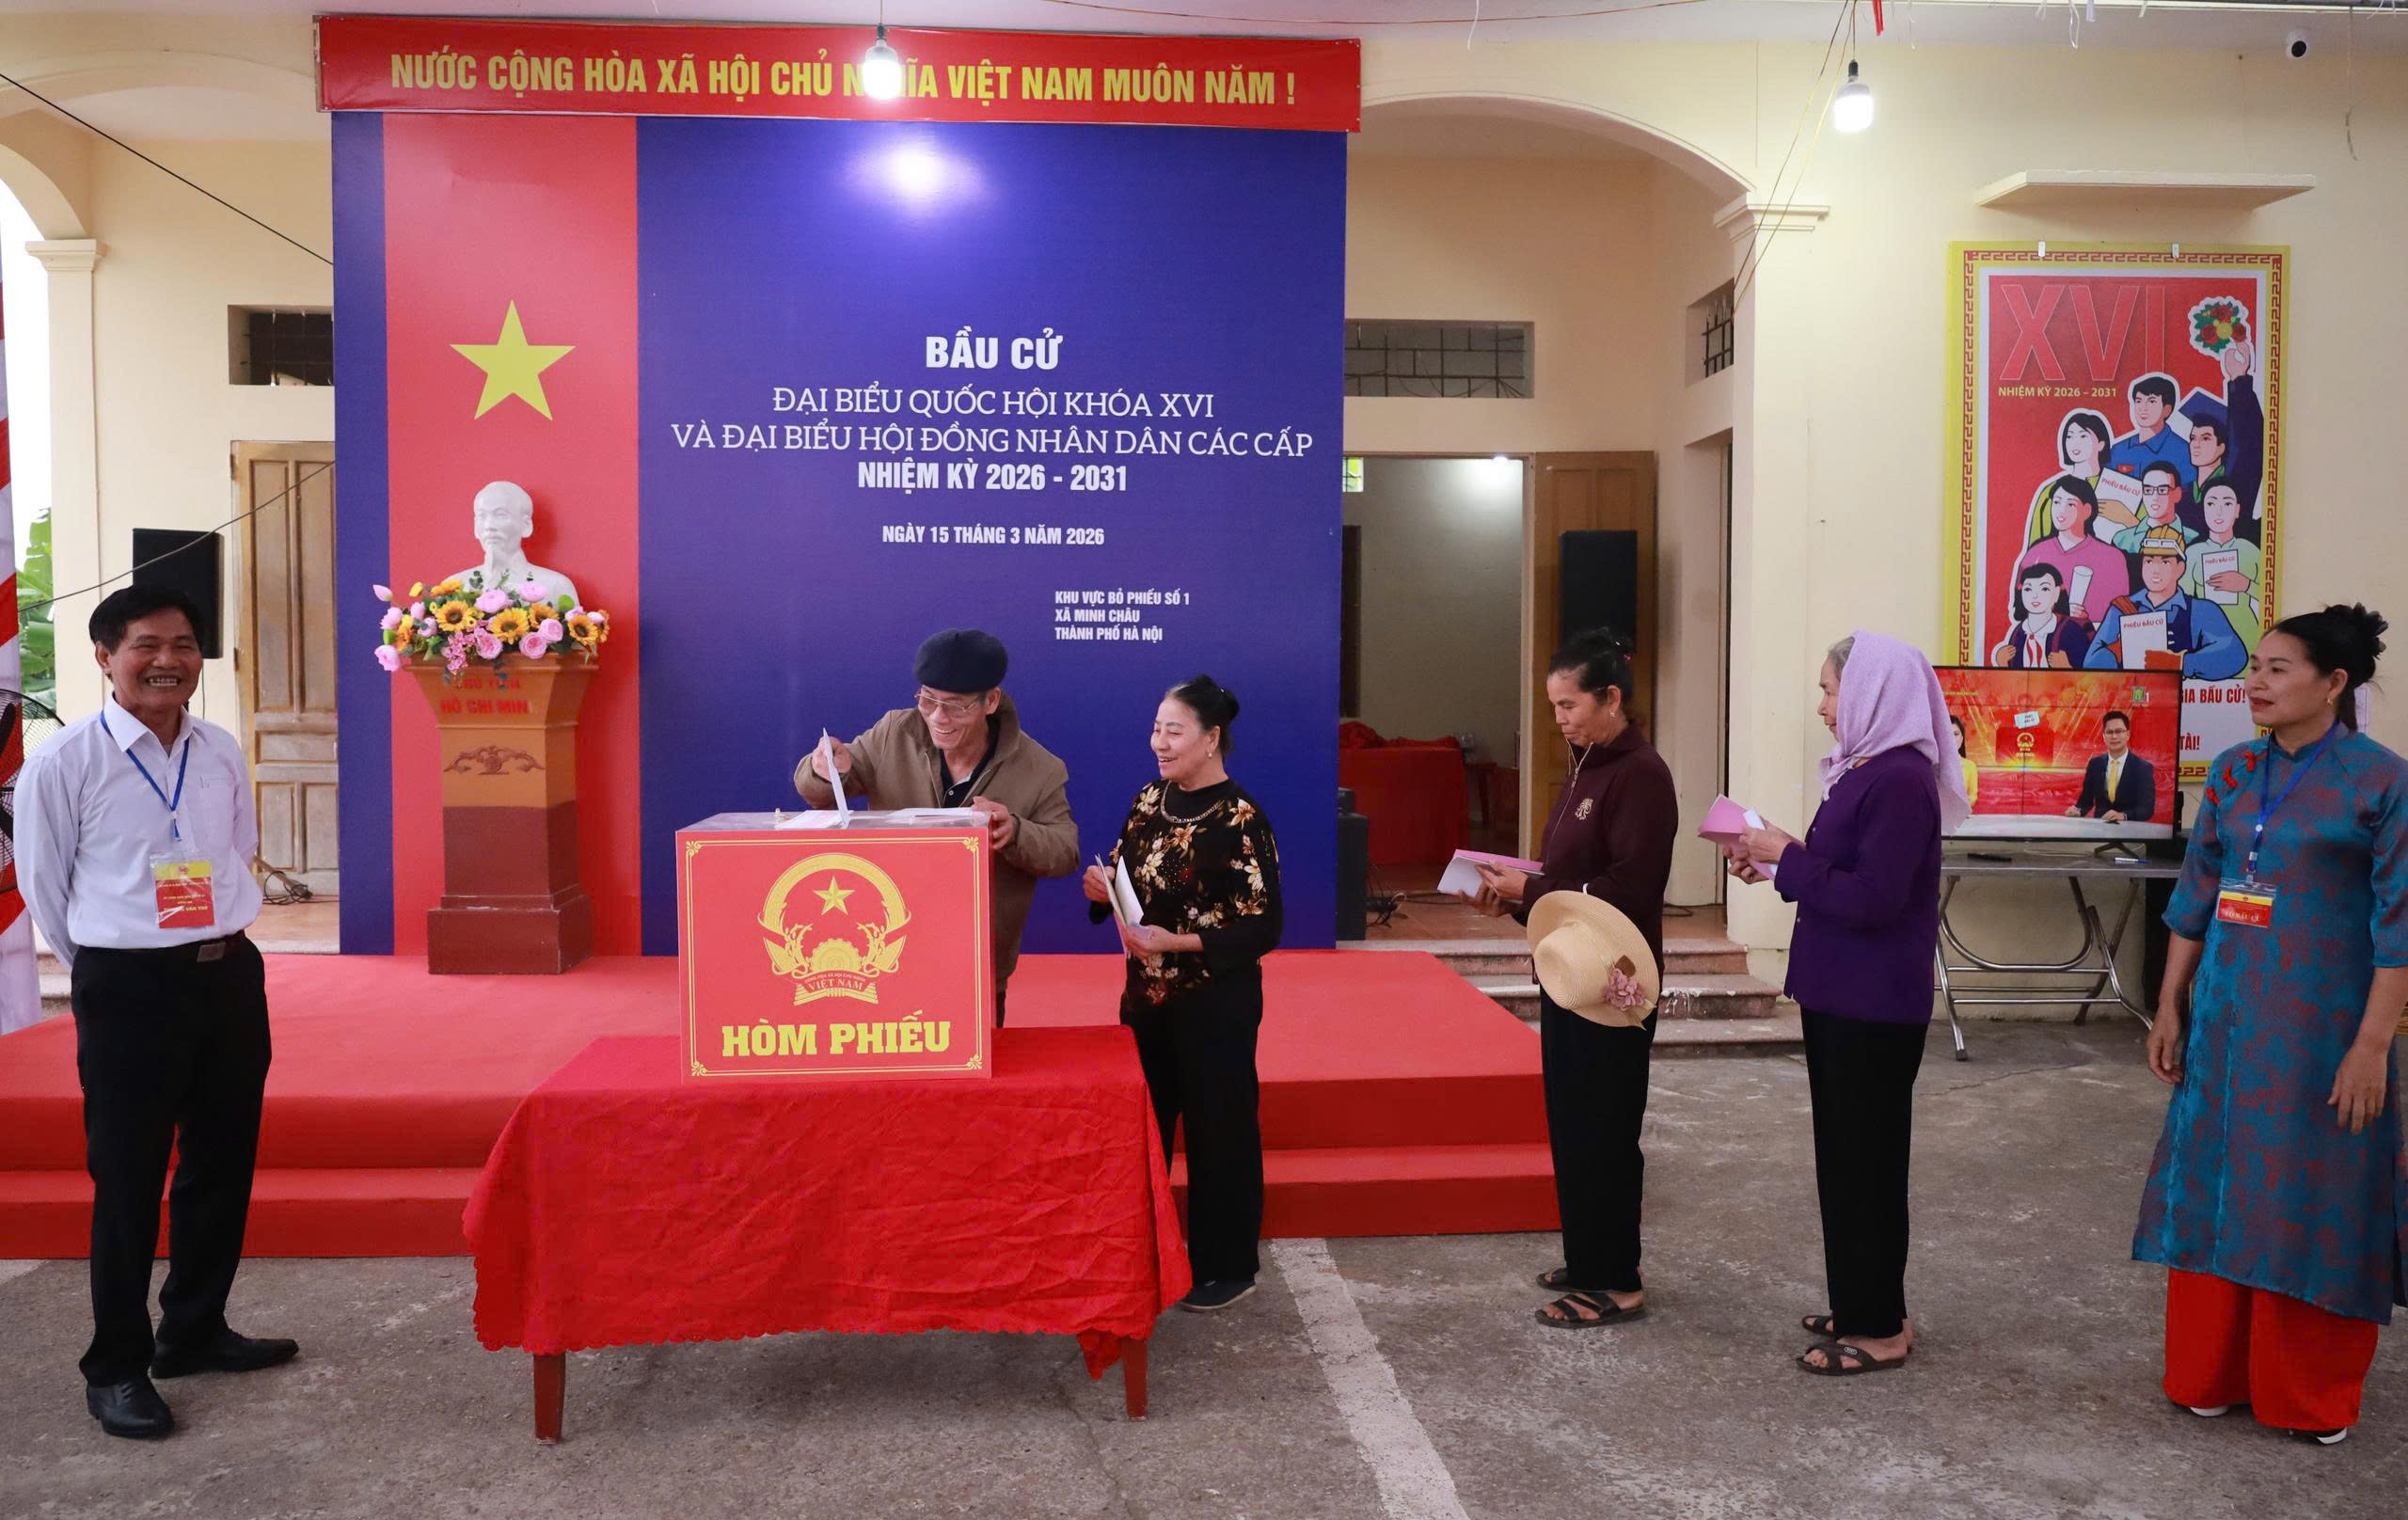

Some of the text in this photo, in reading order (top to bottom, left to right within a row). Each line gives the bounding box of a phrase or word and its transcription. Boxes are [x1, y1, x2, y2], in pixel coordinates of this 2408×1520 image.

[391, 45, 1295, 107] NƯỚC CỘNG HÒA XÃ HỘI CHỦ NĨA VIỆT NAM MUÔN NĂM !
[926, 325, 1064, 371] BẦU CỬ
[2000, 284, 2165, 382] XVI
[772, 380, 1214, 420] ĐẠI BIỂU QUỐC HỘI KHÓA XVI
[1998, 386, 2036, 399] NHIỆM
[2037, 386, 2052, 397] KỲ
[2054, 387, 2081, 397] 2026
[2091, 388, 2116, 397] 2031
[672, 418, 1314, 457] VÀ ĐẠI BIỂU HỘI ĐỒNG NHÂN DÂN CÁC CẤP
[858, 456, 940, 495] NHIỆM
[947, 457, 979, 490] KỲ
[985, 463, 1046, 491] 2026
[1069, 464, 1128, 492] 2031
[882, 522, 1105, 546] NGÀY 15 THÁNG 3 NĂM 2026
[1054, 587, 1190, 607] KHU VỰC BỎ PHIẾU SỐ 1
[1054, 607, 1141, 624] XÃ MINH CHÂU
[1054, 624, 1164, 643] THÀNH PHỐ HÀ NỘI
[2181, 688, 2195, 704] IA
[837, 979, 863, 990] NAM
[721, 1009, 951, 1057] HÒM PHIẾU
